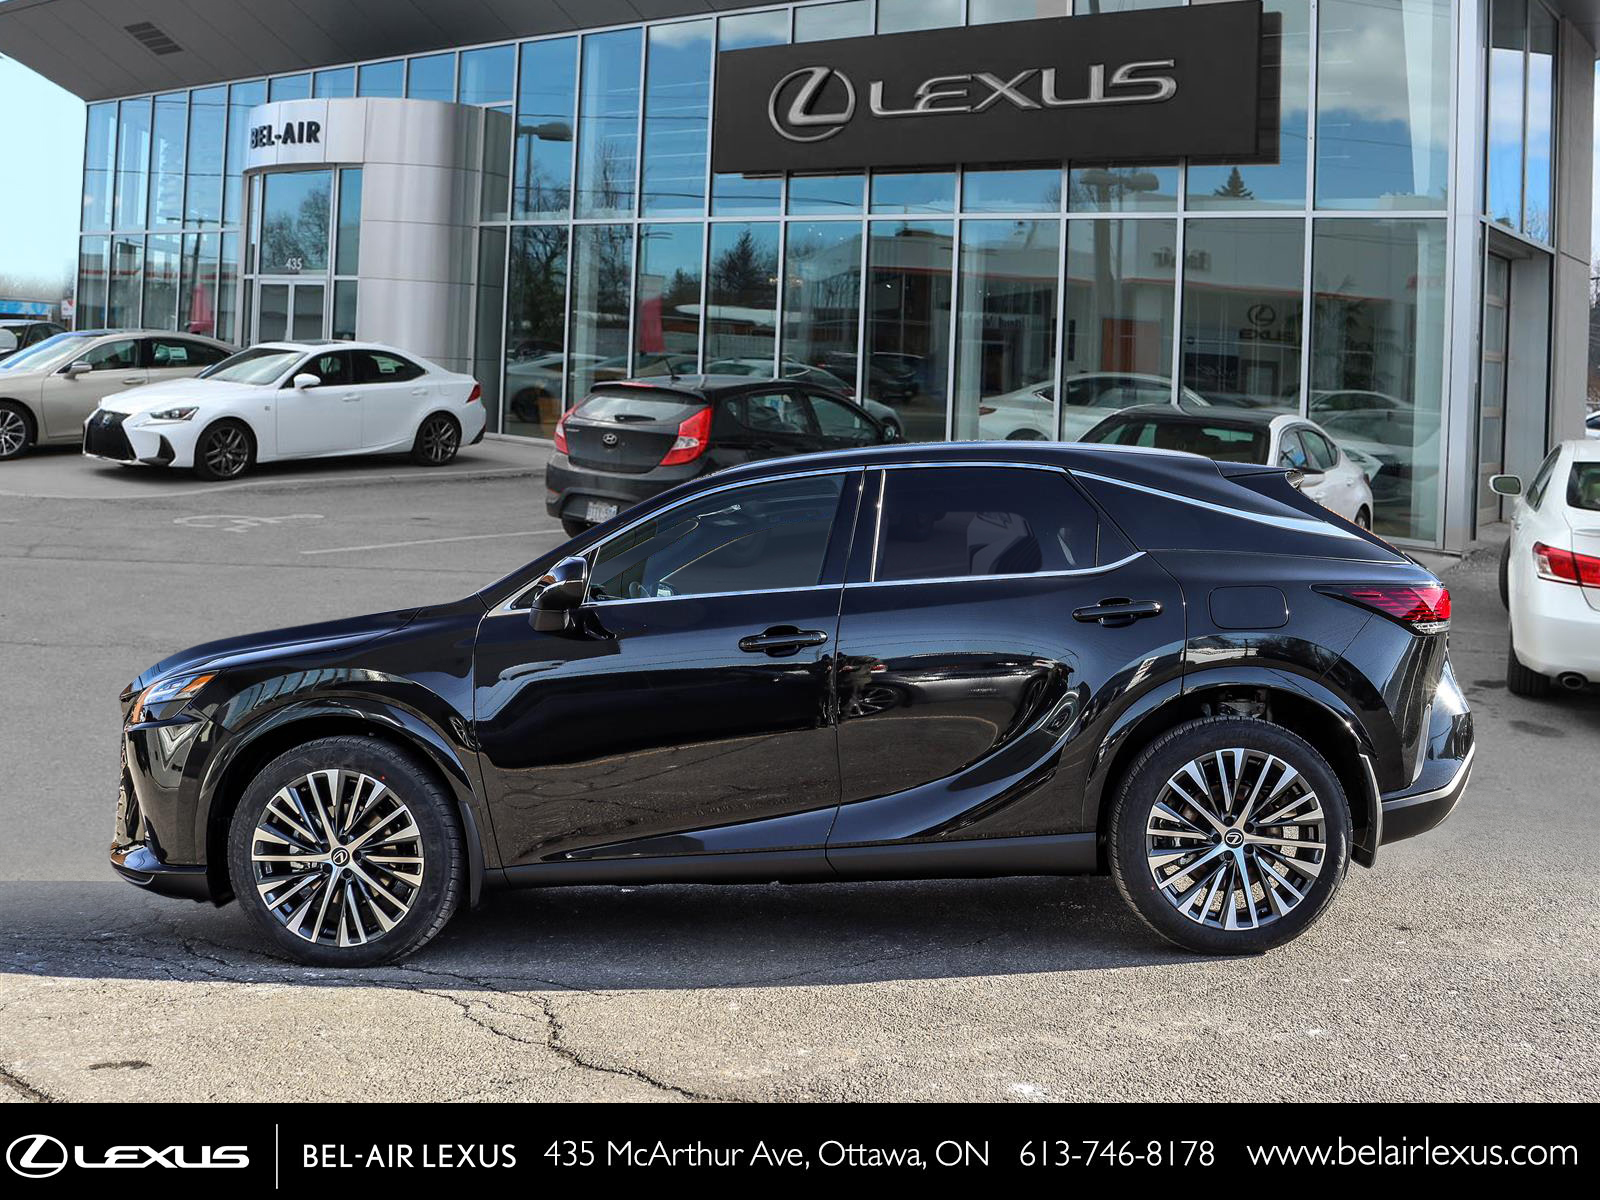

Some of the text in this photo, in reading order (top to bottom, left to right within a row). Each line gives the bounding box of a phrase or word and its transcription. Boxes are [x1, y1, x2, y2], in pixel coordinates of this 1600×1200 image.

[869, 58, 1178, 119] LEXUS
[250, 120, 321, 149] BEL-AIR
[285, 257, 303, 270] 435
